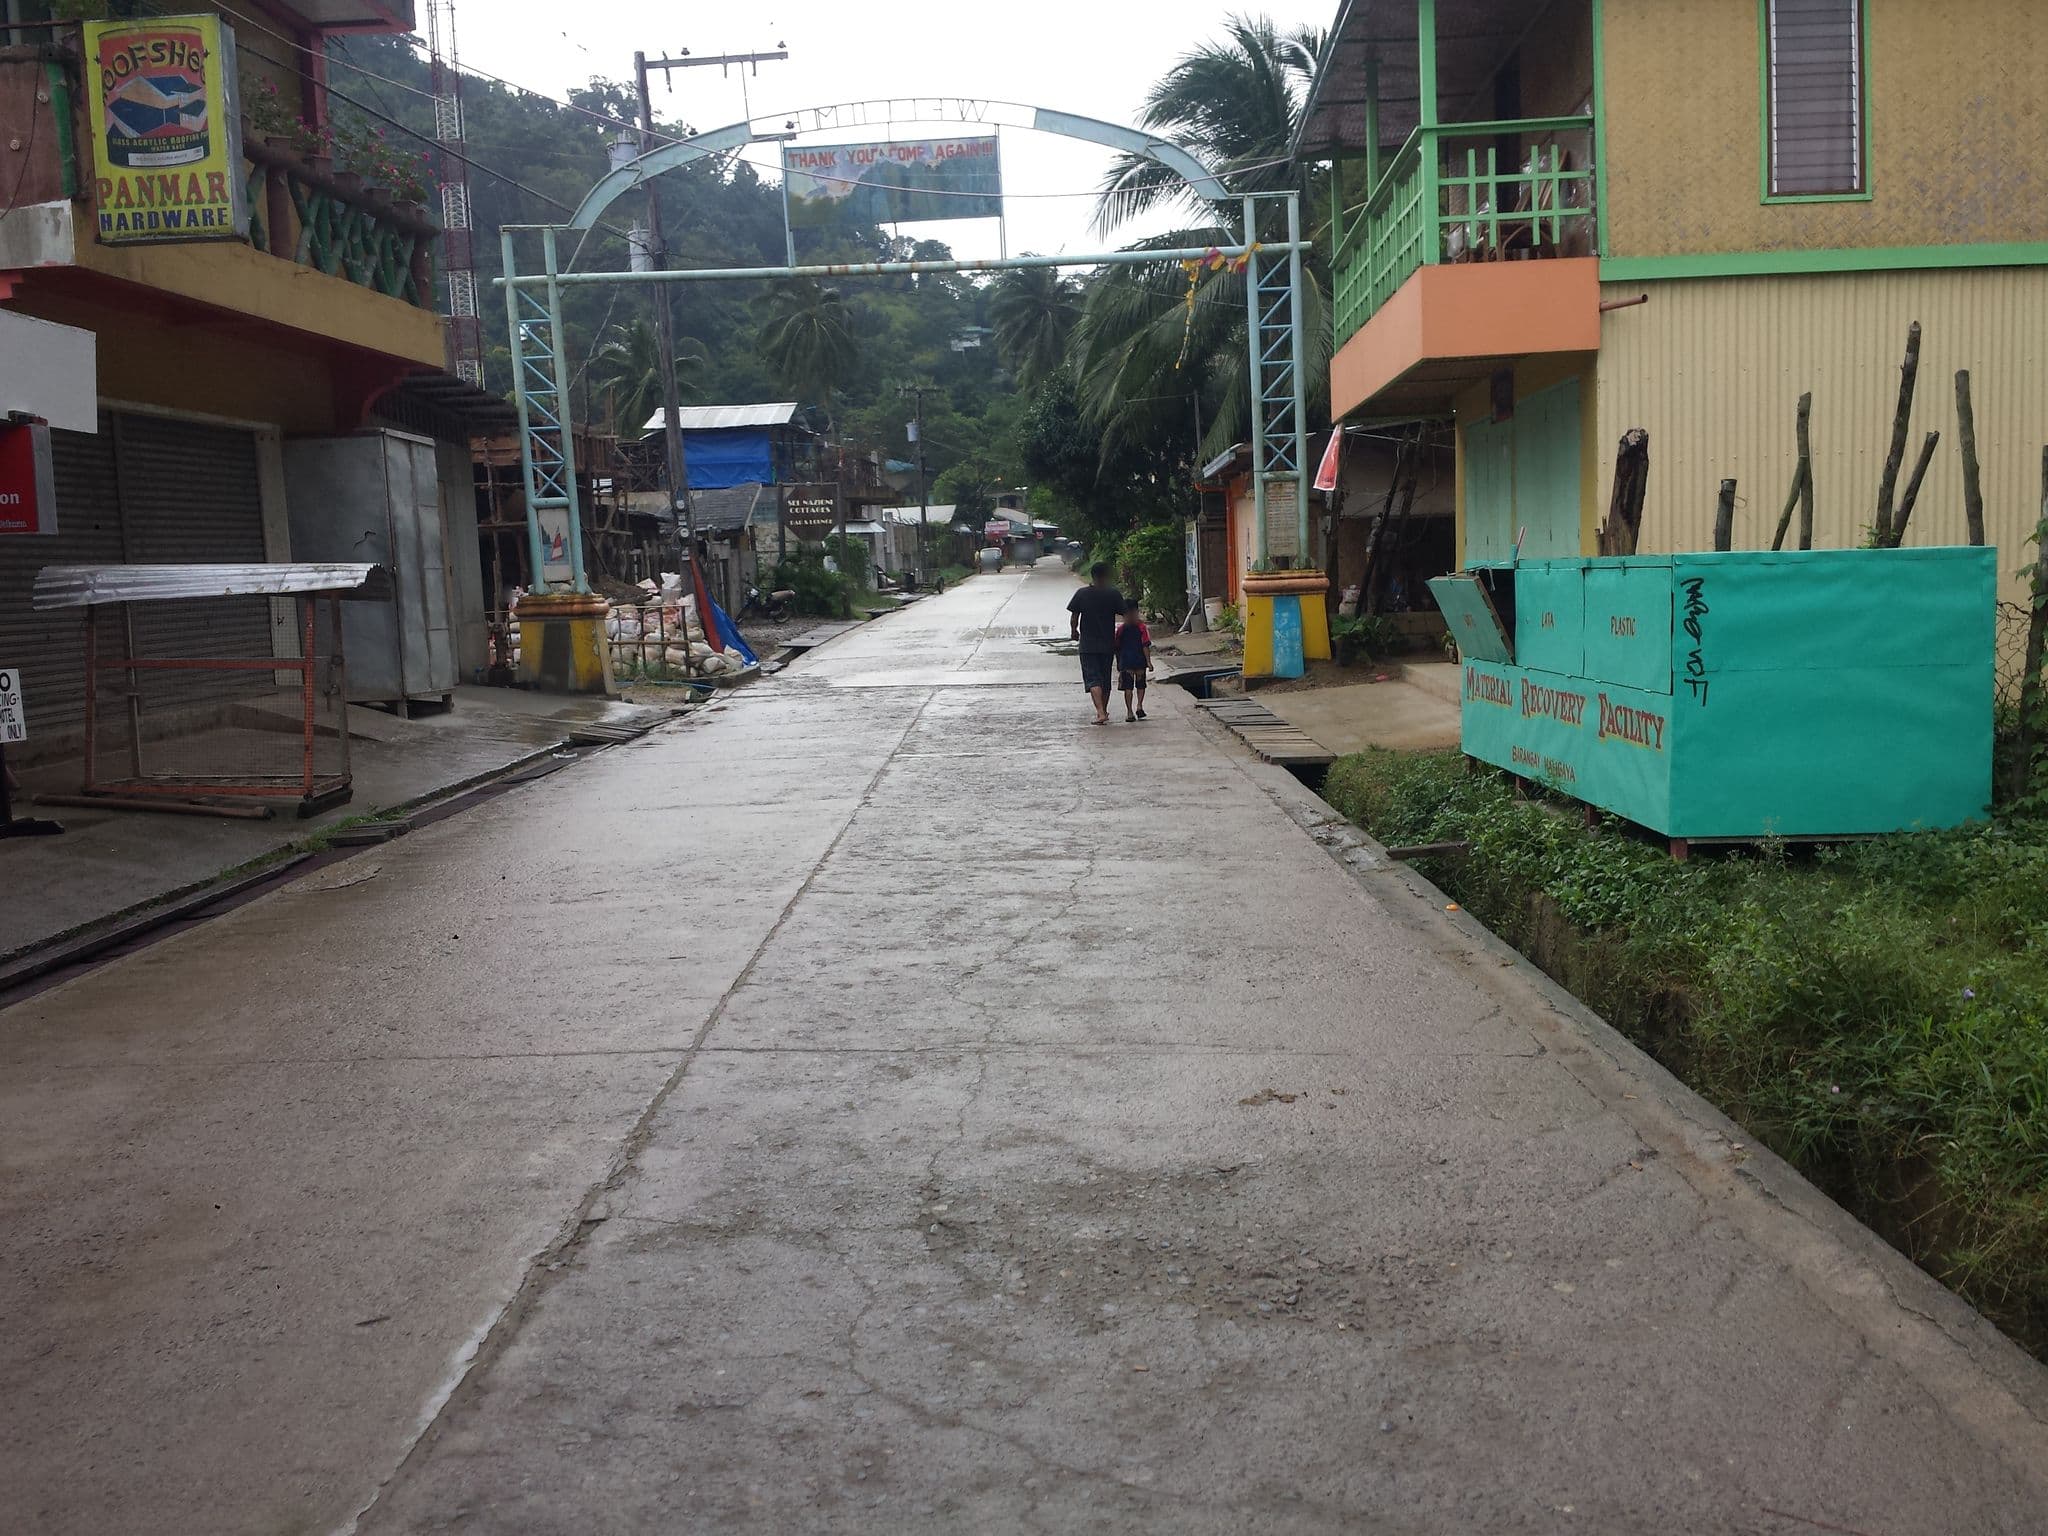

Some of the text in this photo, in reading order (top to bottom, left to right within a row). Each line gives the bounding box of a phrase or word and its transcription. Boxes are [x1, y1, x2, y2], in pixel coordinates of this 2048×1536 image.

[788, 151, 837, 168] THANK
[847, 147, 878, 164] YOU
[96, 172, 229, 209] PANMAR
[100, 208, 228, 231] HARDWARE
[1610, 616, 1636, 637] PLASTIC
[1466, 666, 1665, 750] MATERIAL RECOVERY FACILITY
[1512, 745, 1540, 768] BARANGAY
